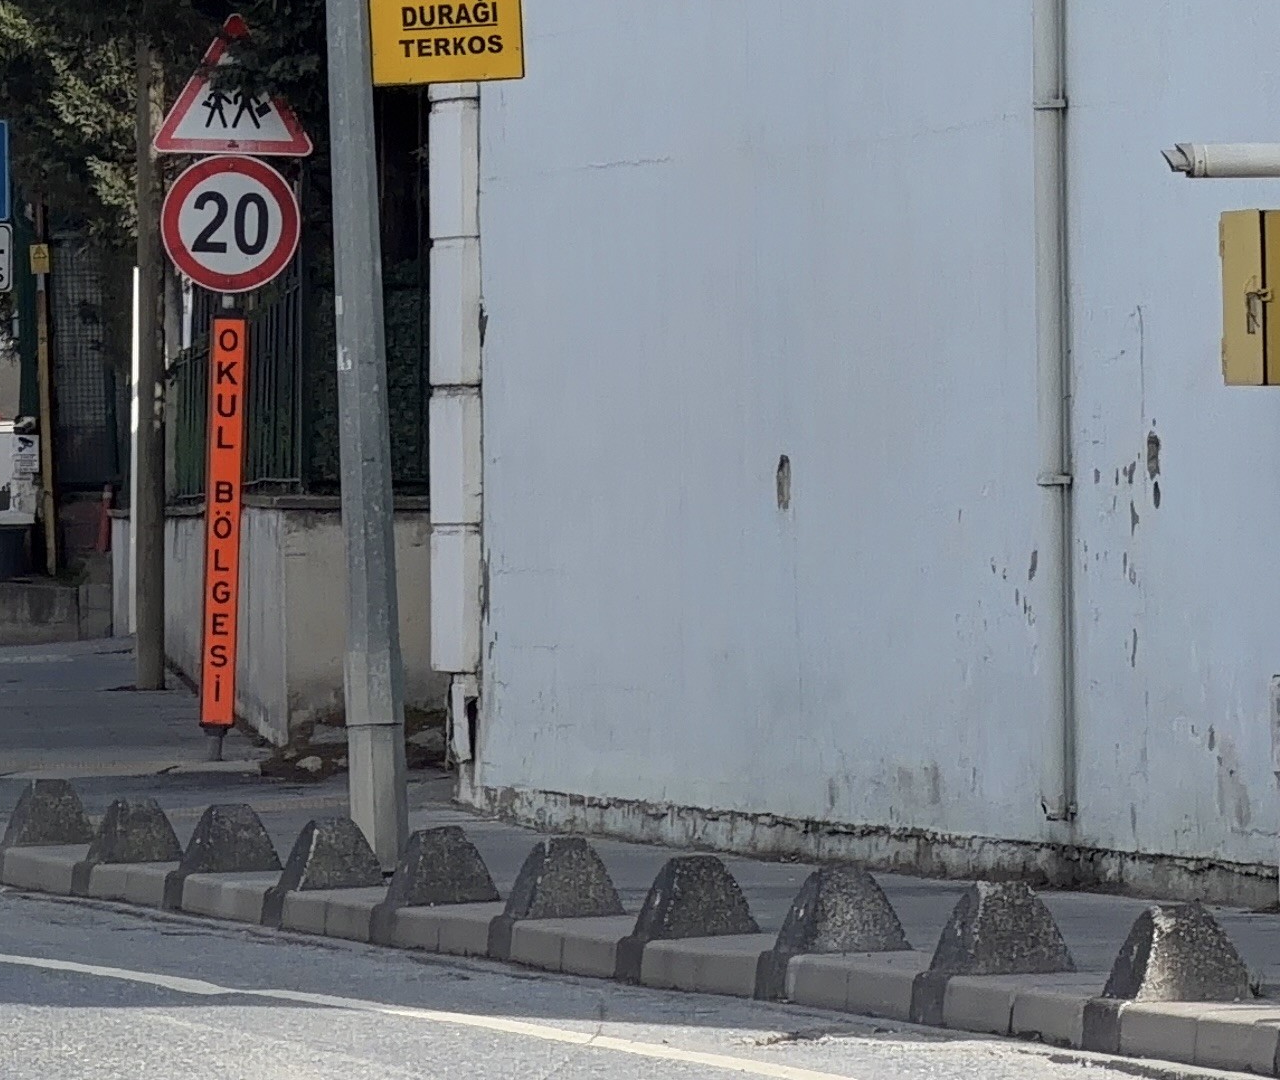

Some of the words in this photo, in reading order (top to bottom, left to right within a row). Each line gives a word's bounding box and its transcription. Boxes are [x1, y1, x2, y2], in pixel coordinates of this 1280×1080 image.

[398, 34, 504, 58] TERKOS
[190, 190, 269, 256] 20
[216, 328, 239, 450] OKUL
[209, 480, 234, 702] BÖLGESİ
